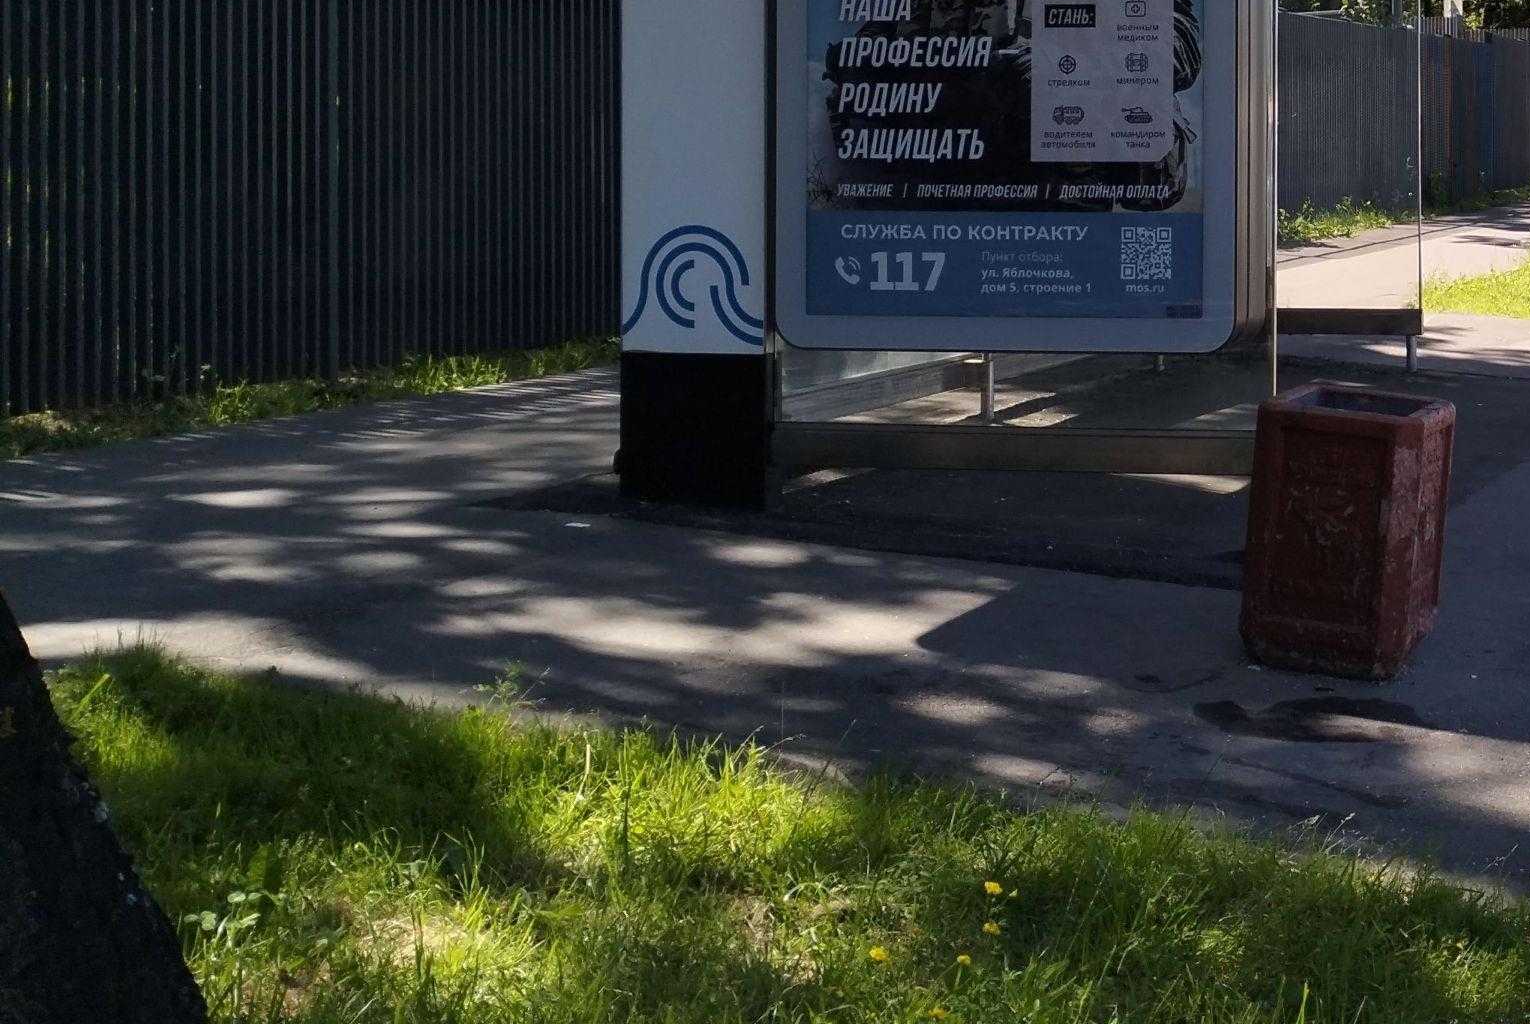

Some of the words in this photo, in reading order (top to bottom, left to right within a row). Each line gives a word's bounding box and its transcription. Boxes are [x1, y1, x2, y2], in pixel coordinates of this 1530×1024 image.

[1047, 7, 1094, 26] СТАНЬ:
[838, 36, 992, 69] ПРОФЕССИЯ
[1047, 79, 1091, 88] стрелком
[838, 82, 942, 116] РОДИНУ
[1110, 131, 1166, 140] командиром
[837, 128, 985, 163] ЗАЩИЩАТЬ
[836, 183, 894, 198] УВАЖЕНИЕ
[917, 183, 971, 198] ПОЧЕТНАЯ
[973, 183, 1038, 198] ПРОФЕССИЯ
[1058, 181, 1124, 199] ДОСТОЙНАЯ
[1126, 183, 1170, 199] ОПЛАТА
[840, 223, 926, 241] СЛУЖБА
[933, 224, 962, 240] ПО
[968, 224, 1089, 241] КОНТРАКТУ
[981, 251, 1017, 264] Пункт
[1018, 250, 1063, 265] отбора:
[870, 251, 946, 292] 117
[981, 268, 999, 280] ул.
[1002, 267, 1073, 280] Яблочкова,
[981, 283, 1007, 295] дом
[1023, 283, 1082, 295] строение
[1085, 282, 1092, 293] 1
[1126, 284, 1165, 295] mos.ru
